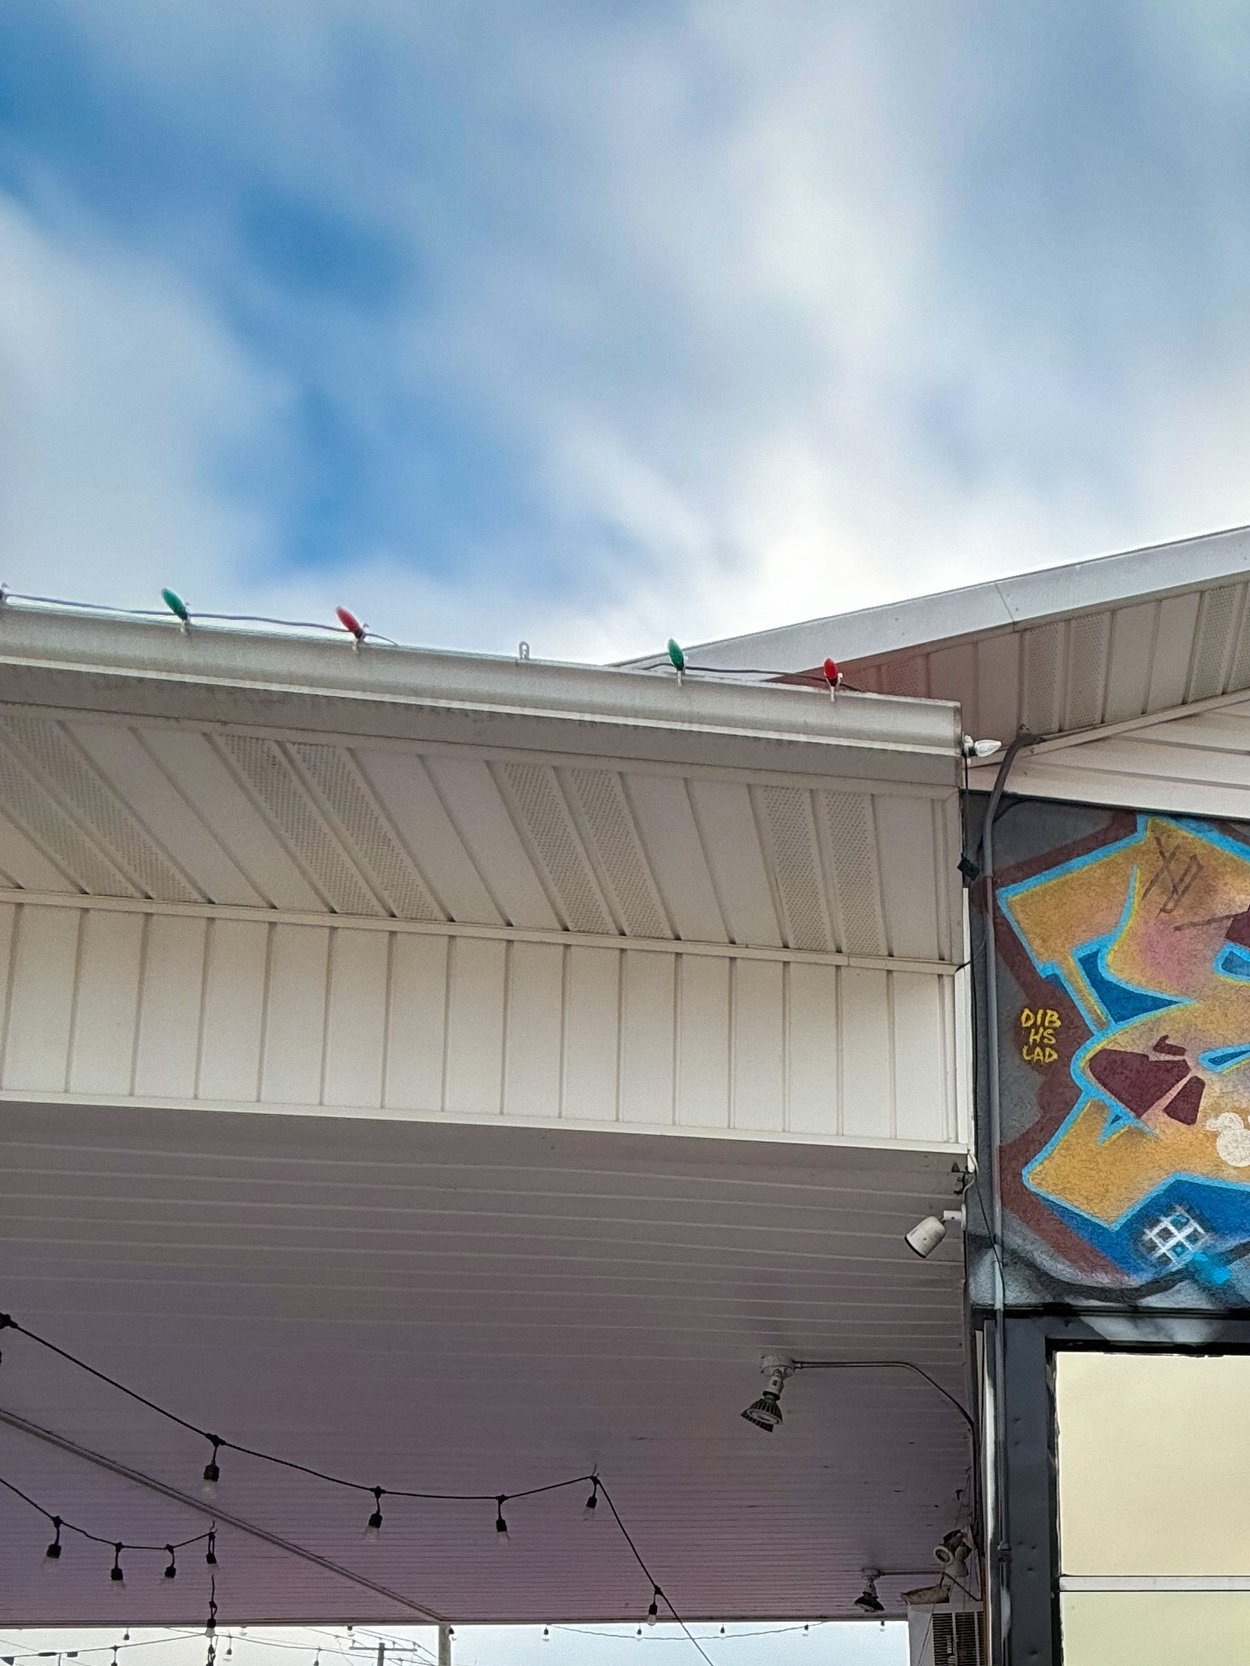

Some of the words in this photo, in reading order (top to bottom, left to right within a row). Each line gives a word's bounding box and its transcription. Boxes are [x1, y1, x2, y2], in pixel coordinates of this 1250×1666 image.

[1021, 1007, 1061, 1028] DIB
[1029, 1027, 1056, 1045] HS
[1022, 1045, 1058, 1063] LAD
